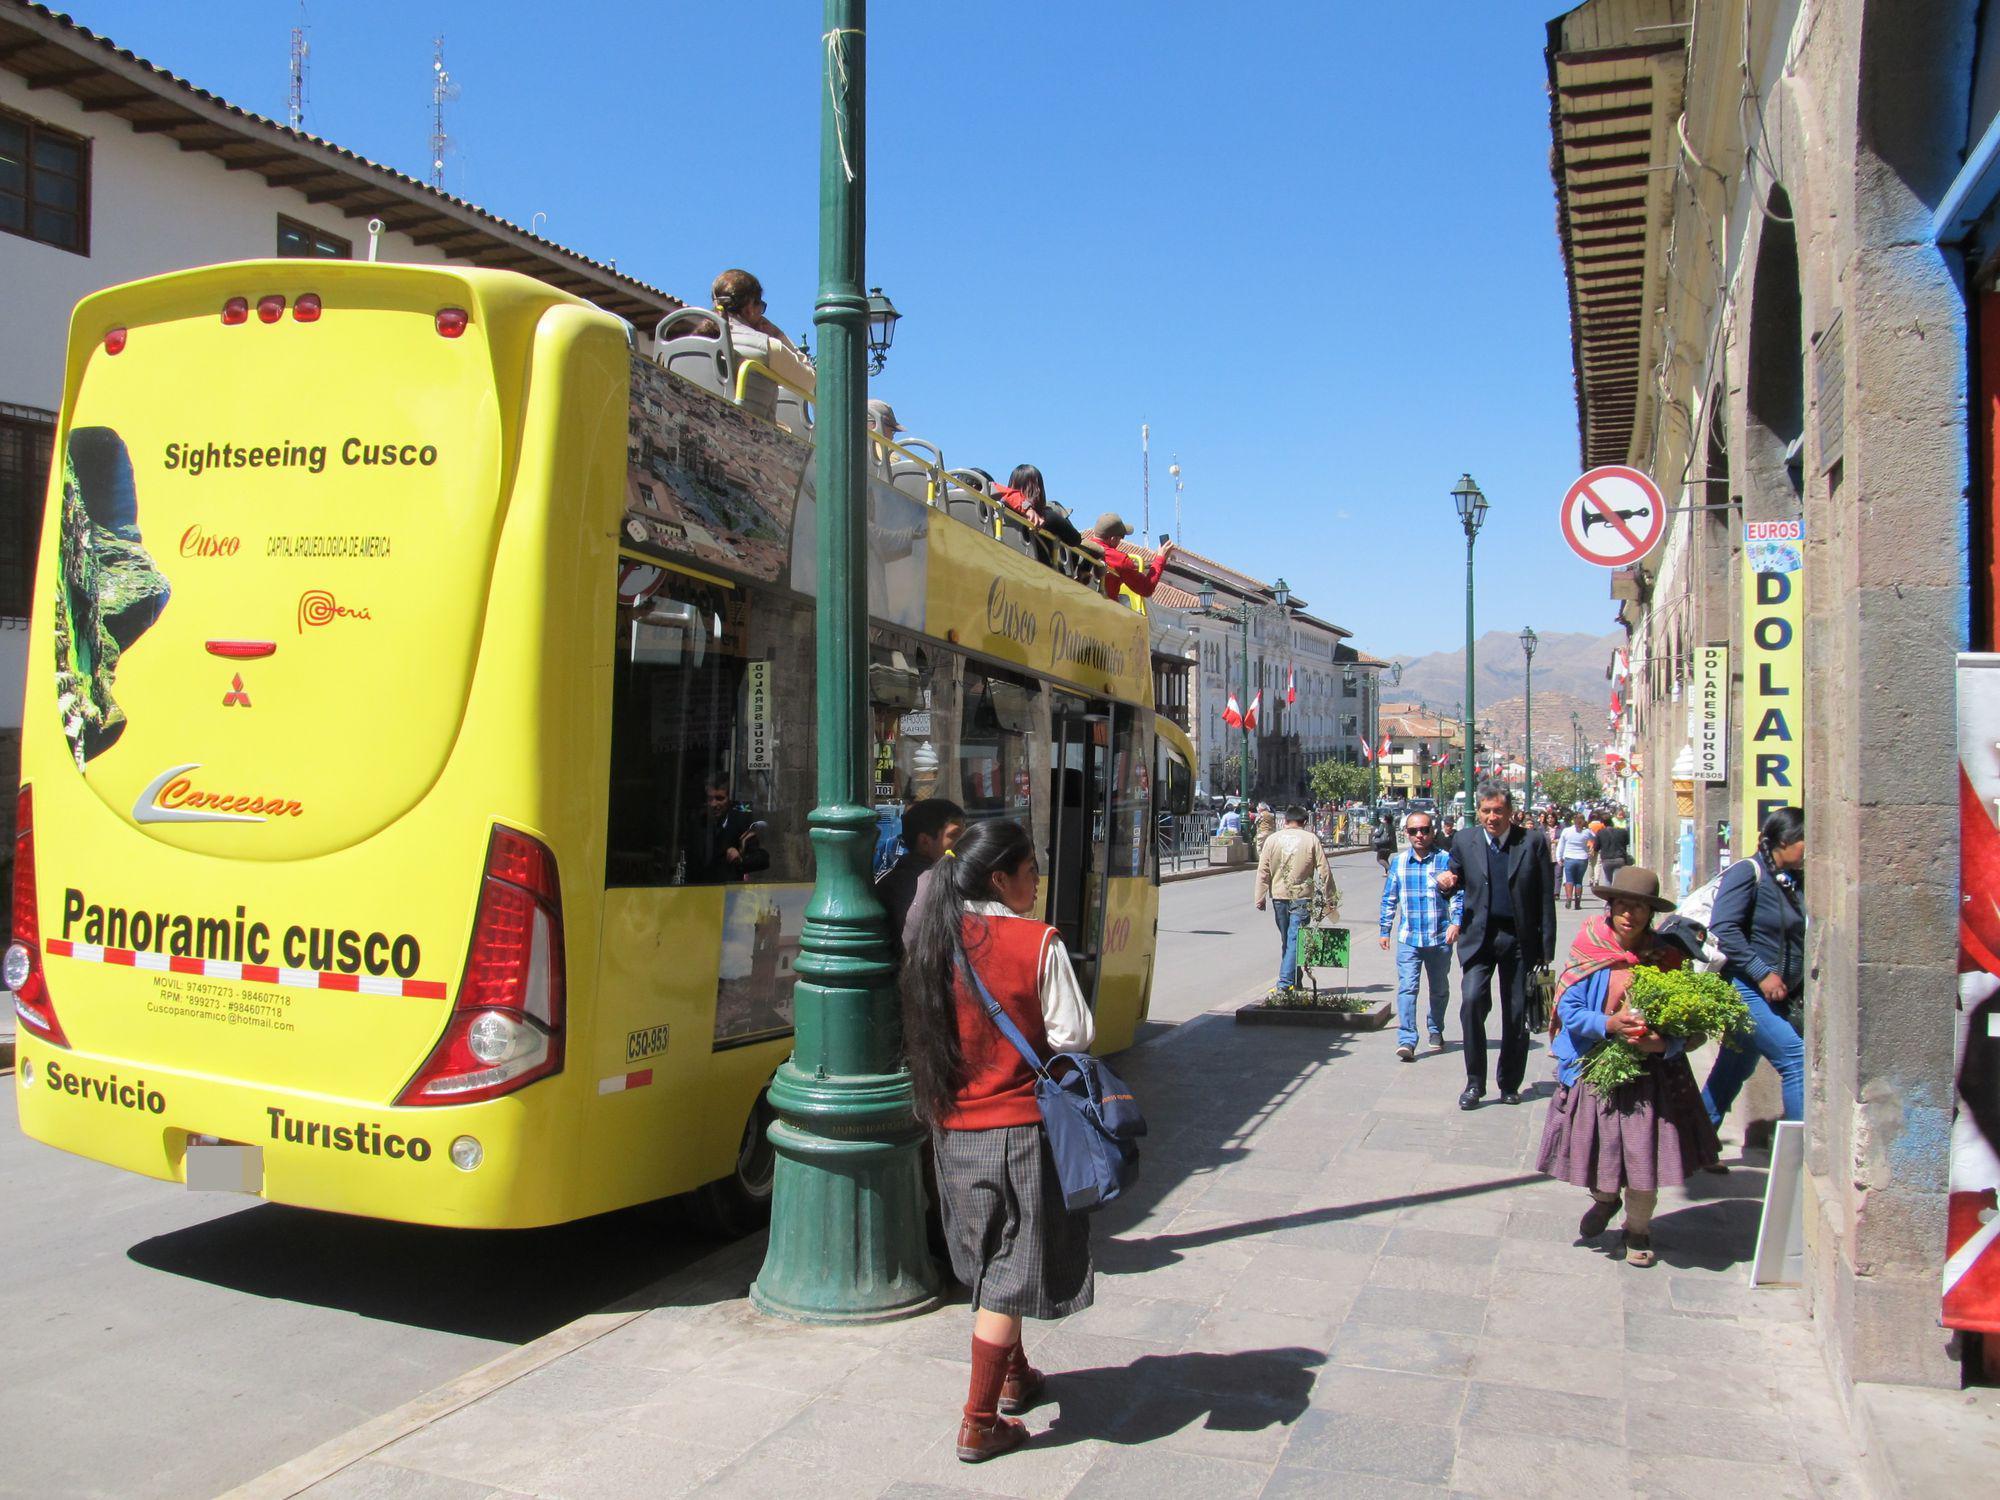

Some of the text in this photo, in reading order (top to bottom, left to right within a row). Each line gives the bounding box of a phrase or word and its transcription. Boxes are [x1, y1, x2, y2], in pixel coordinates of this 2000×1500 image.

[164, 437, 438, 476] Sightseeing Cusco
[179, 524, 241, 559] Cusco
[267, 536, 391, 558] CAPITAL ARQUEOLOGICA DE AMERICA
[1748, 523, 1798, 539] EUROS
[987, 575, 1037, 646] Cusco
[159, 778, 304, 817] Carcesar
[62, 887, 421, 979] Panoramic cusco
[153, 976, 184, 990] MOVIL:
[186, 981, 234, 998] 974977273
[241, 990, 291, 1006] 984607718
[160, 989, 183, 1003] RPM:
[228, 1002, 283, 1018] #984607718
[628, 1026, 668, 1058] C5Q-953
[46, 1061, 167, 1115] Servicio
[266, 1106, 432, 1162] Turistico
